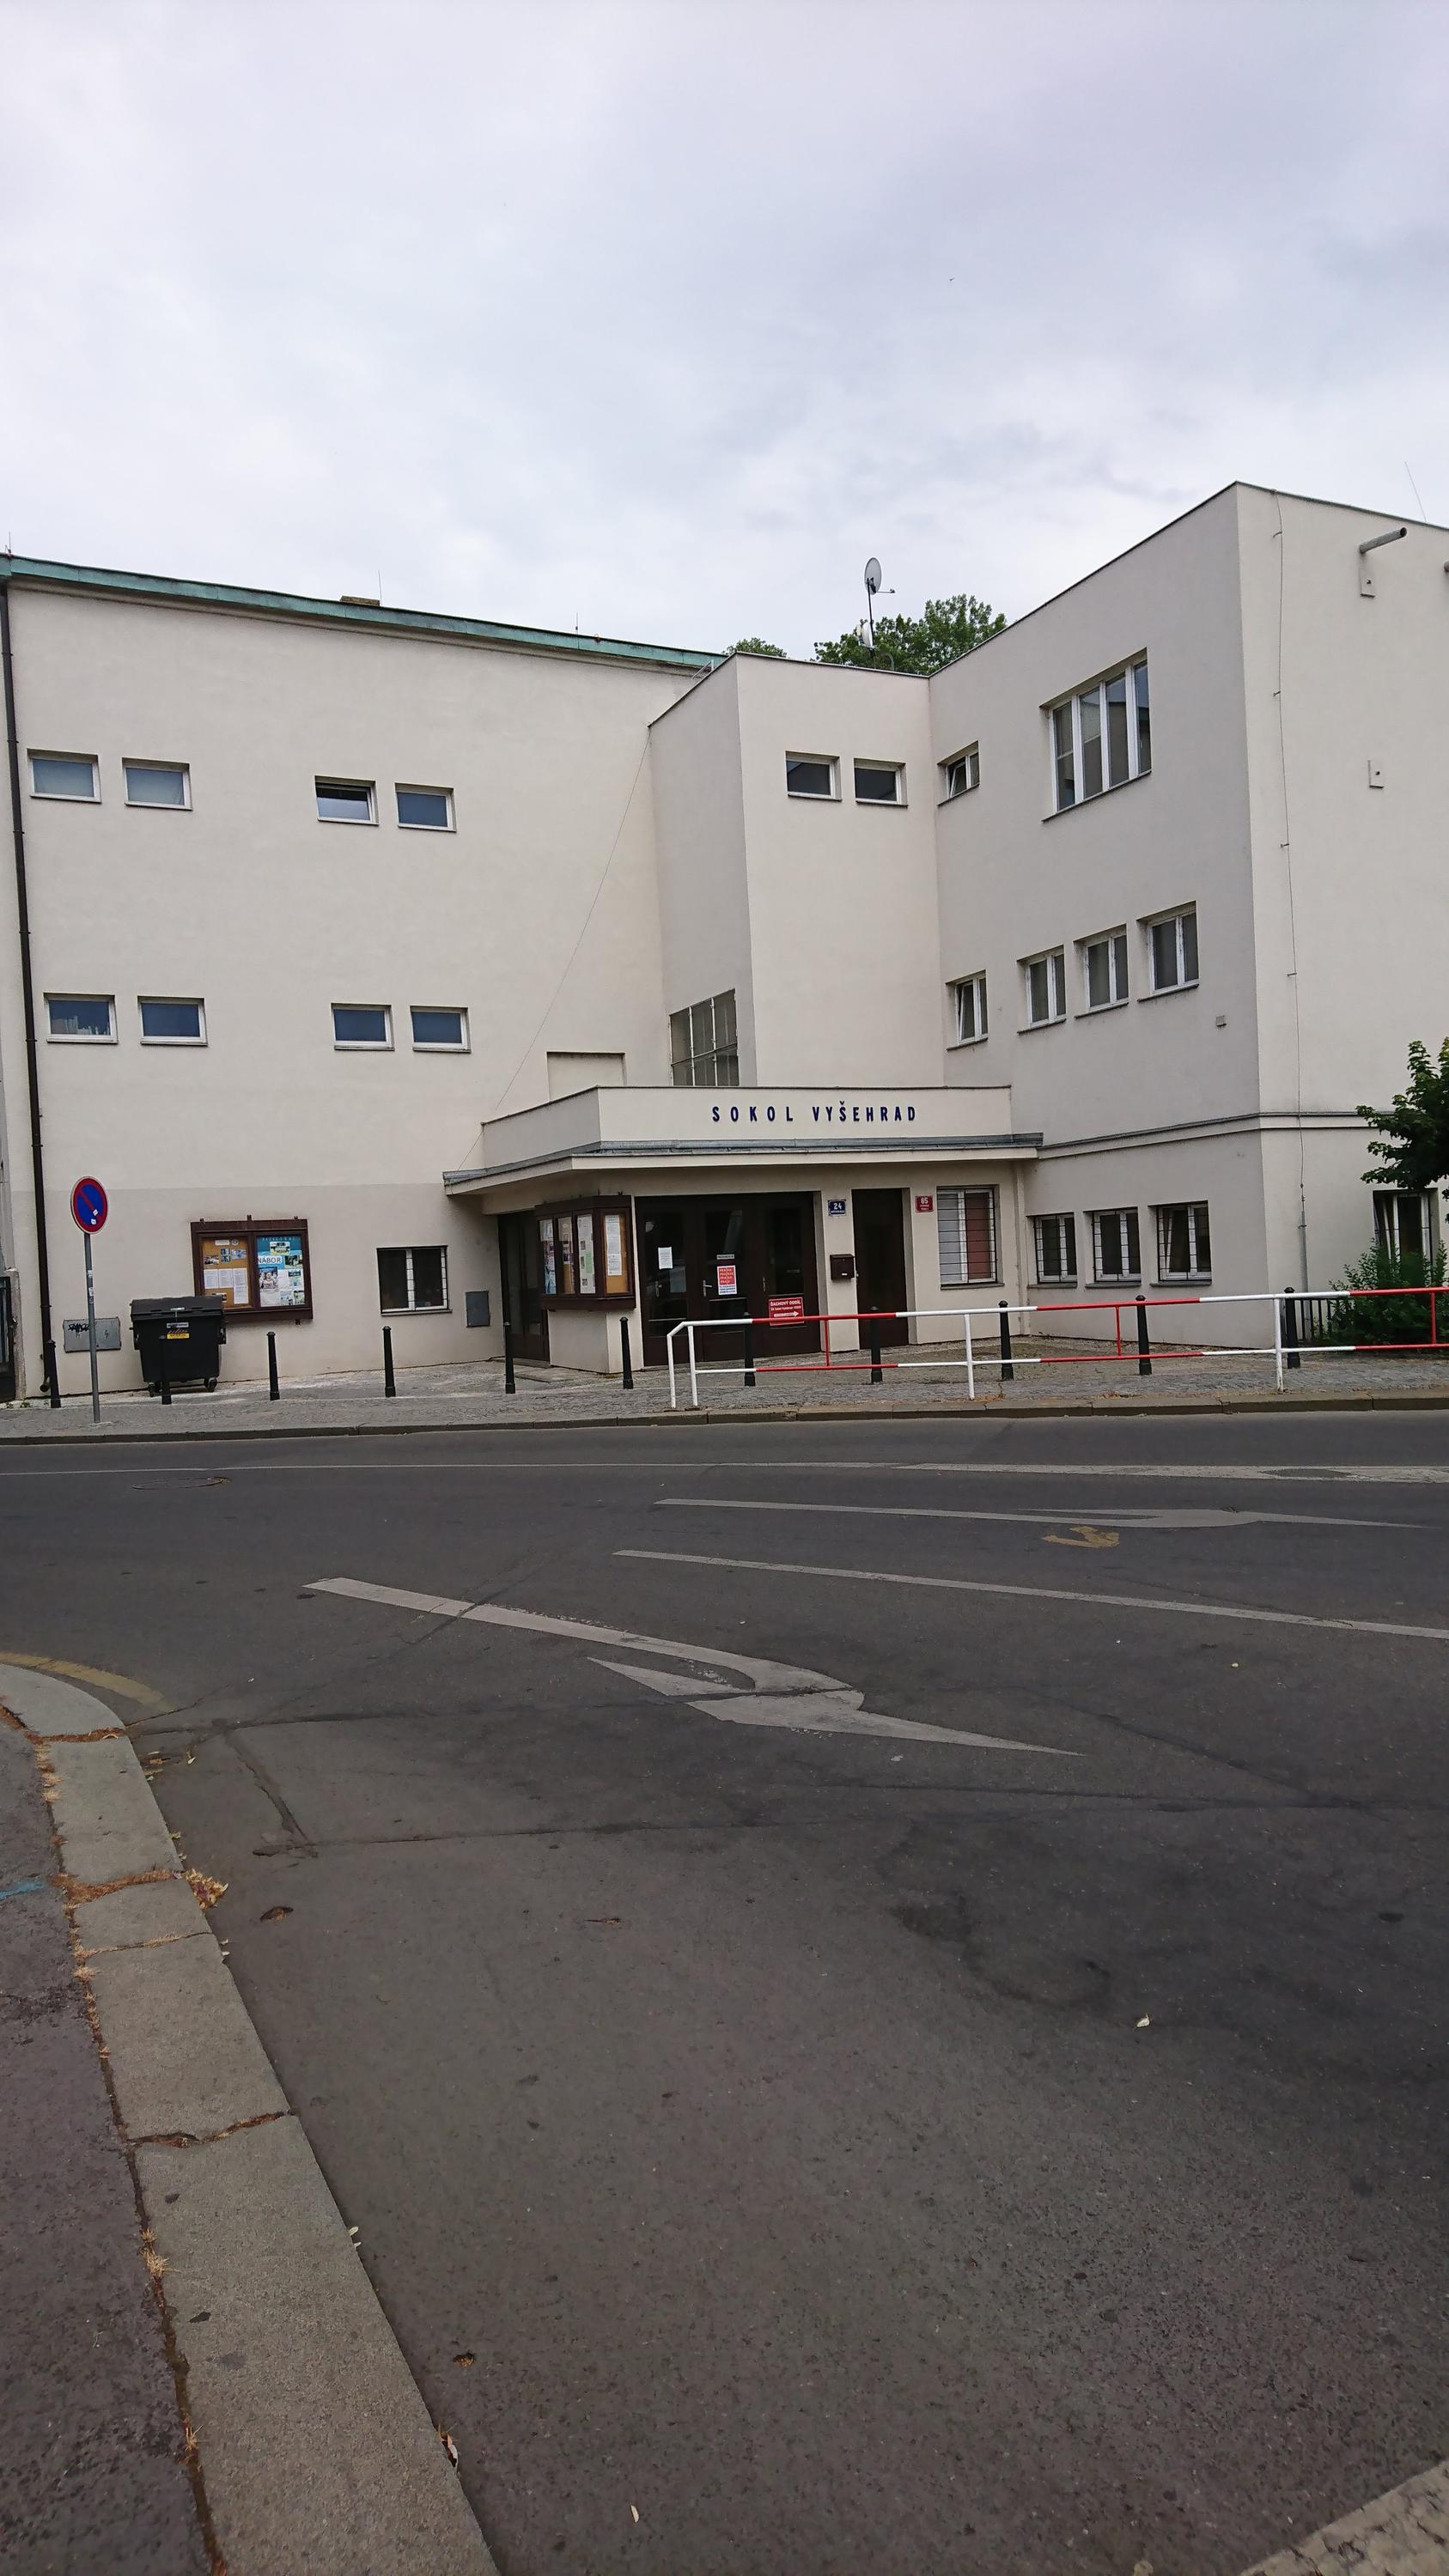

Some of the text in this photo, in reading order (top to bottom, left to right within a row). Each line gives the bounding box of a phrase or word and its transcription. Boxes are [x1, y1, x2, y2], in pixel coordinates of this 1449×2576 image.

[712, 1100, 916, 1122] SOKOL VYŠEHRAD
[258, 1255, 282, 1264] NÁBOR
